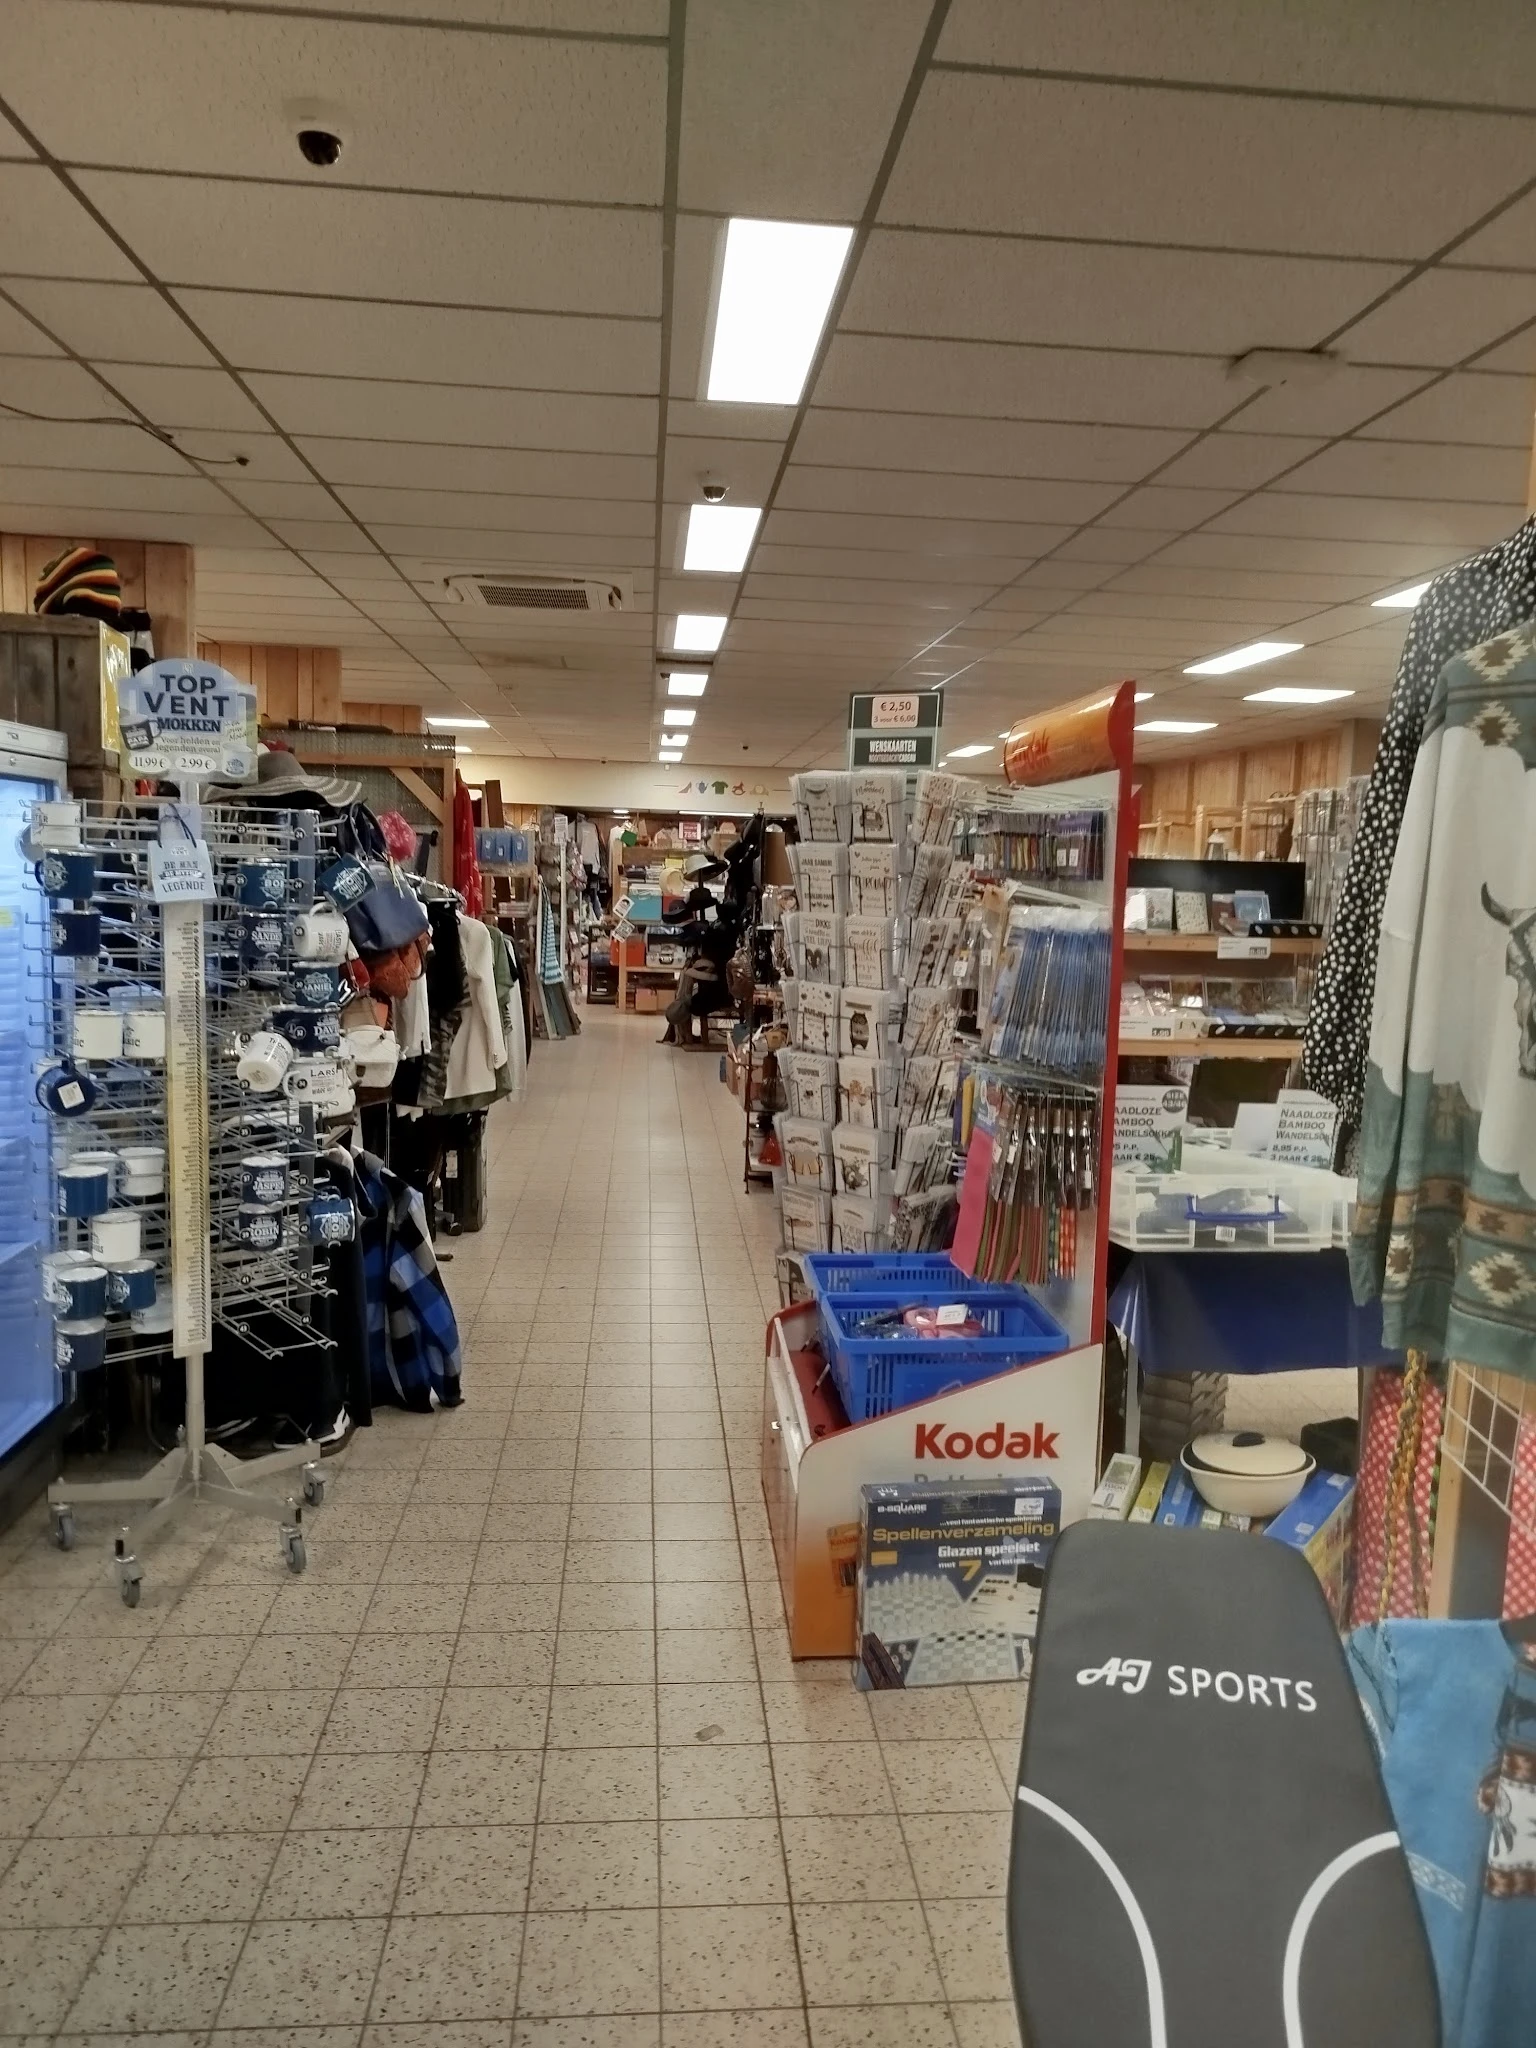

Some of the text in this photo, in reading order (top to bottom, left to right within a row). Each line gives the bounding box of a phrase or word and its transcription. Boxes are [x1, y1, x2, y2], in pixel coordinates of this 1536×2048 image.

[160, 674, 217, 694] TOP
[144, 691, 229, 717] VENT
[889, 701, 912, 712] 2,50
[157, 716, 221, 733] MOKKEN
[869, 739, 917, 753] WENSKAARTEN
[162, 881, 205, 893] LEGENDE
[310, 1067, 336, 1077] LARS
[1115, 1107, 1162, 1116] AADLOZE
[1281, 1108, 1335, 1119] NAADLOZE
[1115, 1118, 1154, 1127] AMBOO
[1278, 1119, 1326, 1130] BAMBOO
[1114, 1153, 1132, 1161] AAR
[253, 1180, 285, 1191] JASPER
[914, 1422, 1060, 1460] Kodak
[872, 1522, 1055, 1544] Spellenverzameling
[938, 1541, 1040, 1558] Glazen speelset
[938, 1560, 956, 1569] met
[958, 1559, 982, 1581] 7
[1076, 1657, 1318, 1712] AJ SPORTS
